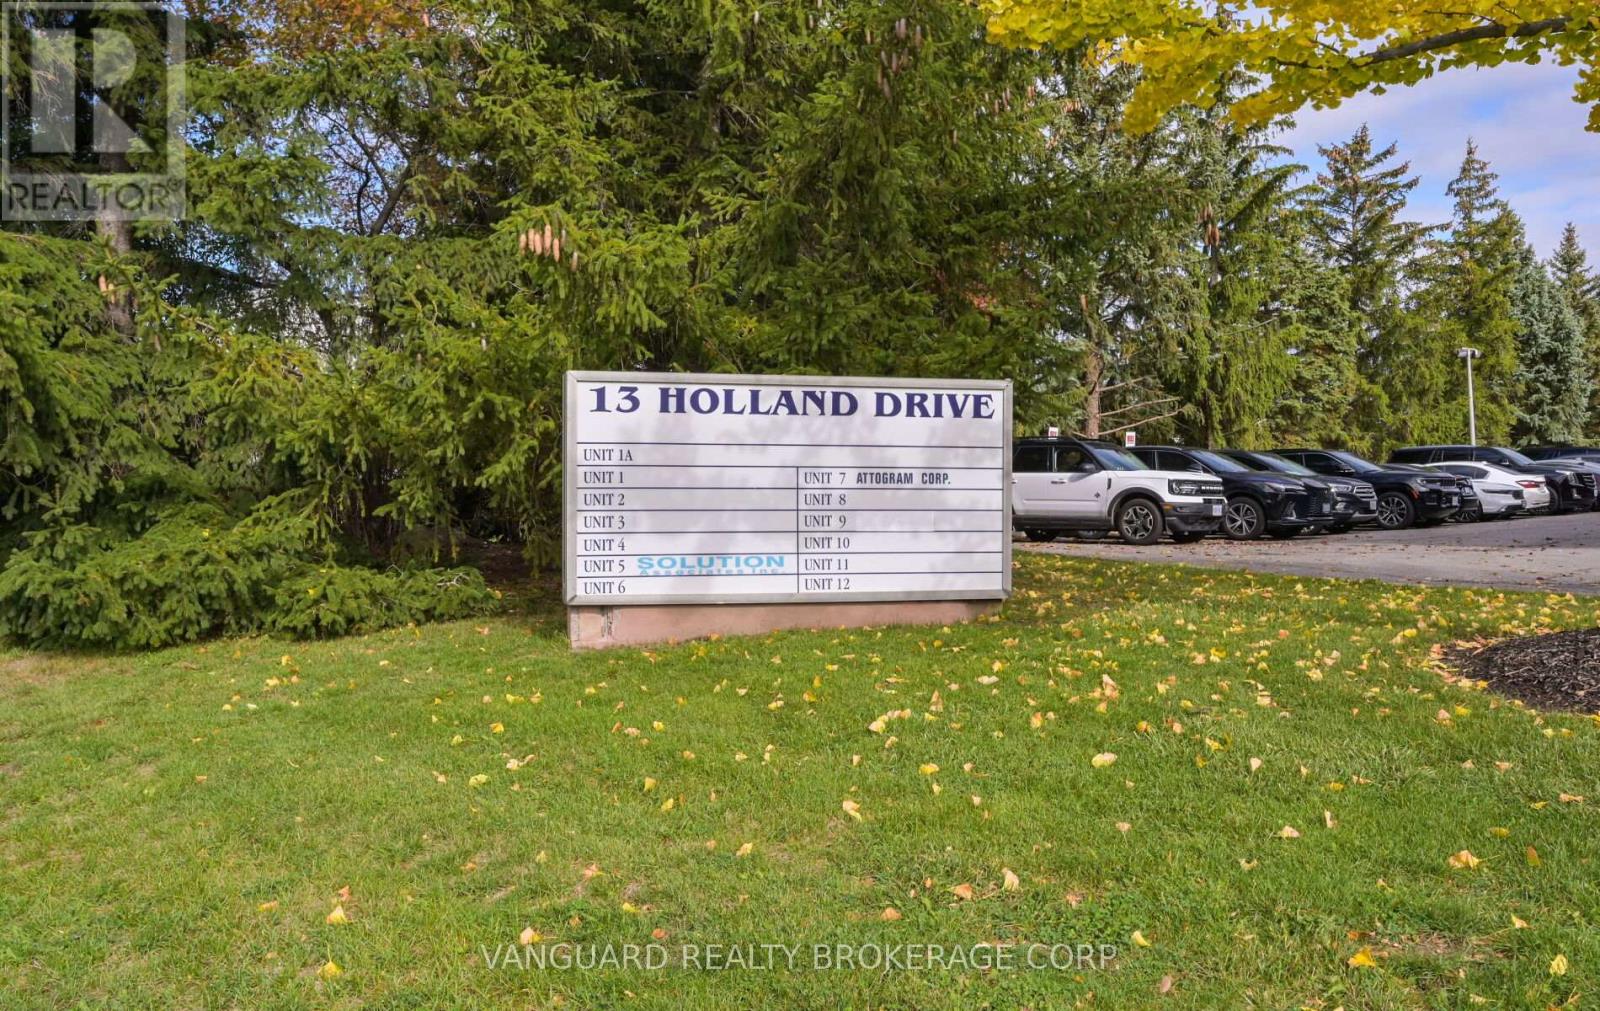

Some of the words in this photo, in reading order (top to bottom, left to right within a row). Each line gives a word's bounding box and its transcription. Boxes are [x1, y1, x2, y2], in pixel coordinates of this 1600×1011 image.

[590, 385, 641, 413] 13
[659, 387, 859, 417] HOLLAND
[875, 392, 996, 419] DRIVE
[584, 449, 614, 461] UNIT
[619, 449, 633, 462] 1A
[584, 471, 614, 484] UNIT
[619, 472, 624, 484] 1
[804, 472, 832, 484] UNIT
[839, 473, 846, 484] 7
[856, 472, 913, 484] ATTOGRAM
[921, 473, 951, 485] CORP.
[584, 494, 614, 506] UNIT
[618, 494, 625, 506] 2
[804, 494, 832, 505] UNIT
[839, 494, 846, 505] 8
[584, 516, 614, 528] UNIT
[618, 516, 625, 529] 3
[804, 516, 832, 527] UNIT
[839, 516, 846, 528] 9
[584, 539, 614, 551] UNIT
[618, 538, 625, 551] 4
[804, 537, 832, 549] UNIT
[837, 537, 850, 549] 10
[584, 560, 614, 572] UNIT
[619, 559, 625, 573] 5
[637, 556, 785, 569] SOLUTION
[805, 559, 832, 570] UNIT
[837, 559, 848, 570] 11
[584, 582, 614, 595] UNIT
[618, 581, 626, 594] 6
[805, 579, 833, 590] UNIT
[837, 578, 850, 590] 12
